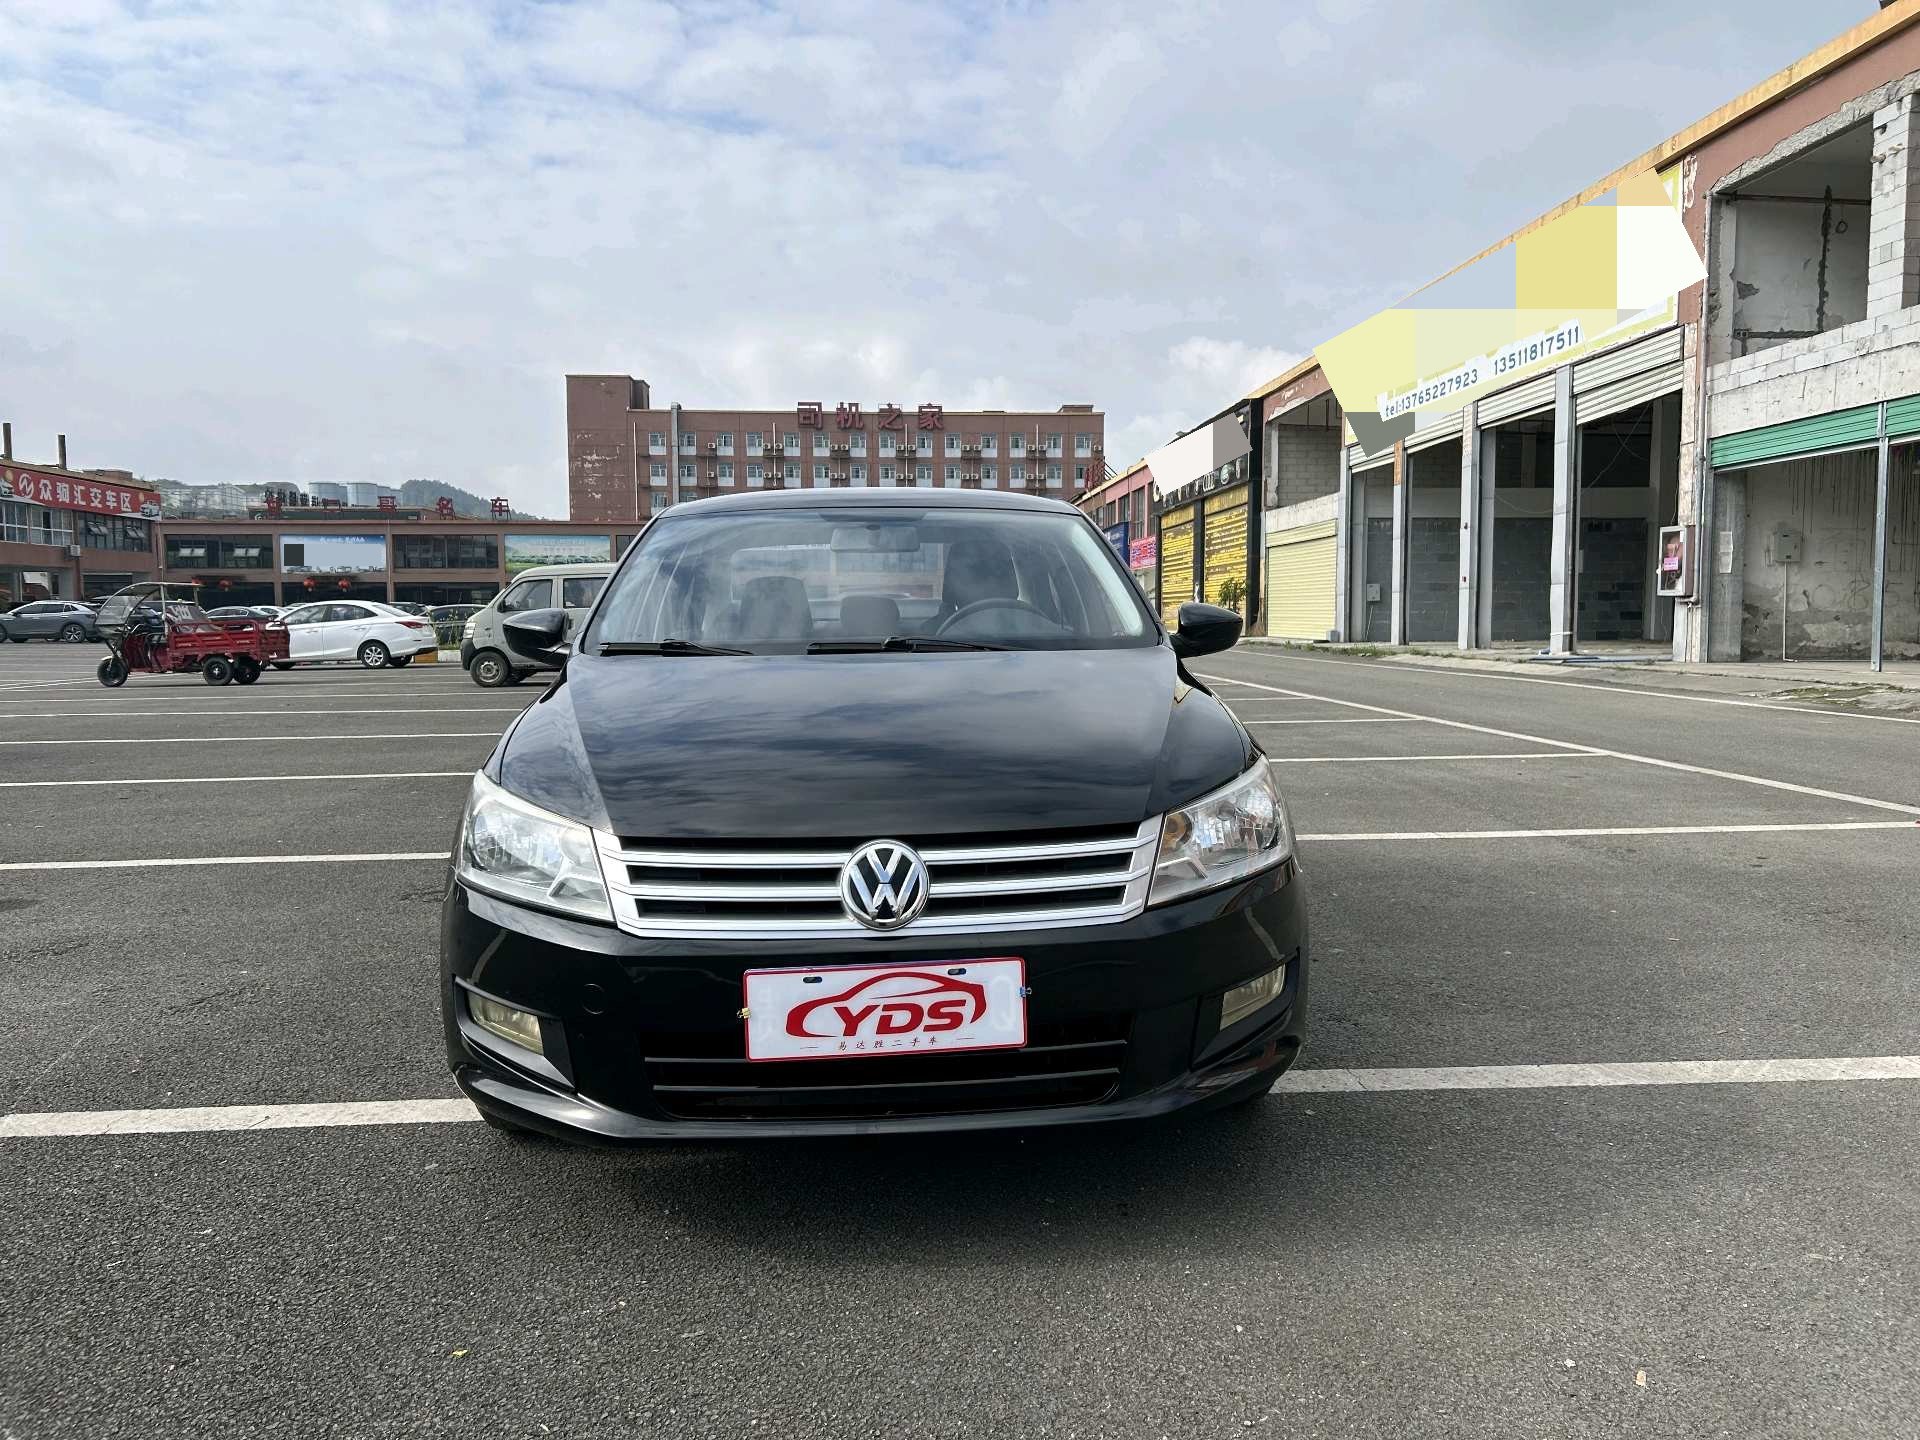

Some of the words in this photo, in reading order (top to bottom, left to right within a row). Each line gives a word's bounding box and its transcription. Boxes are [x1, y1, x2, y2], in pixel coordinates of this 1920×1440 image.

[1385, 369, 1479, 417] tel:13765227923
[1494, 326, 1579, 376] 13511817511
[797, 402, 944, 430] 司机之家
[833, 999, 967, 1037] YDS
[839, 1036, 937, 1051] 易达胜二手车
